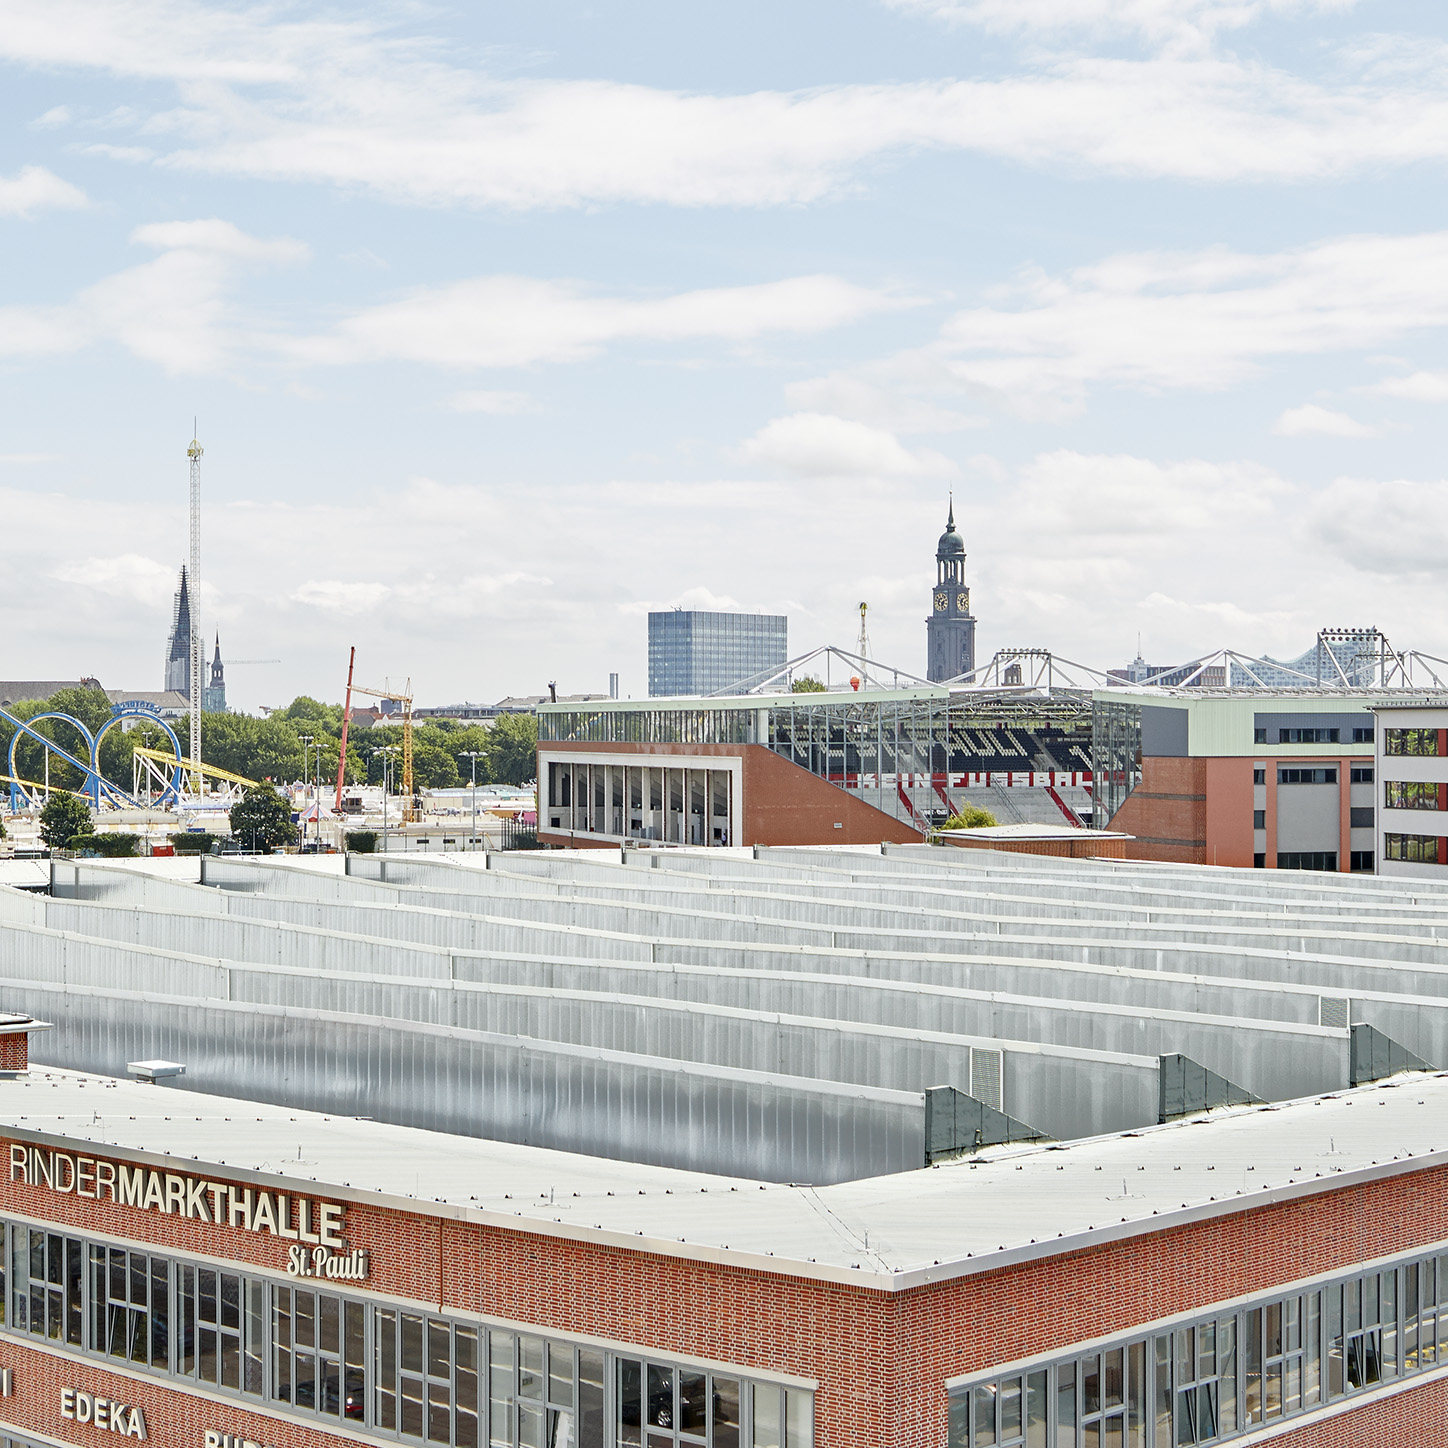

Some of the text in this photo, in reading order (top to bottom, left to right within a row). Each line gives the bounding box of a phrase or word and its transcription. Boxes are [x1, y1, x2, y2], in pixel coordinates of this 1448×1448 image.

[857, 773, 931, 788] KEIN
[10, 1144, 345, 1248] RINDERMARKTHALLE
[312, 1246, 366, 1280] Pauli
[60, 1389, 147, 1440] EDEKA
